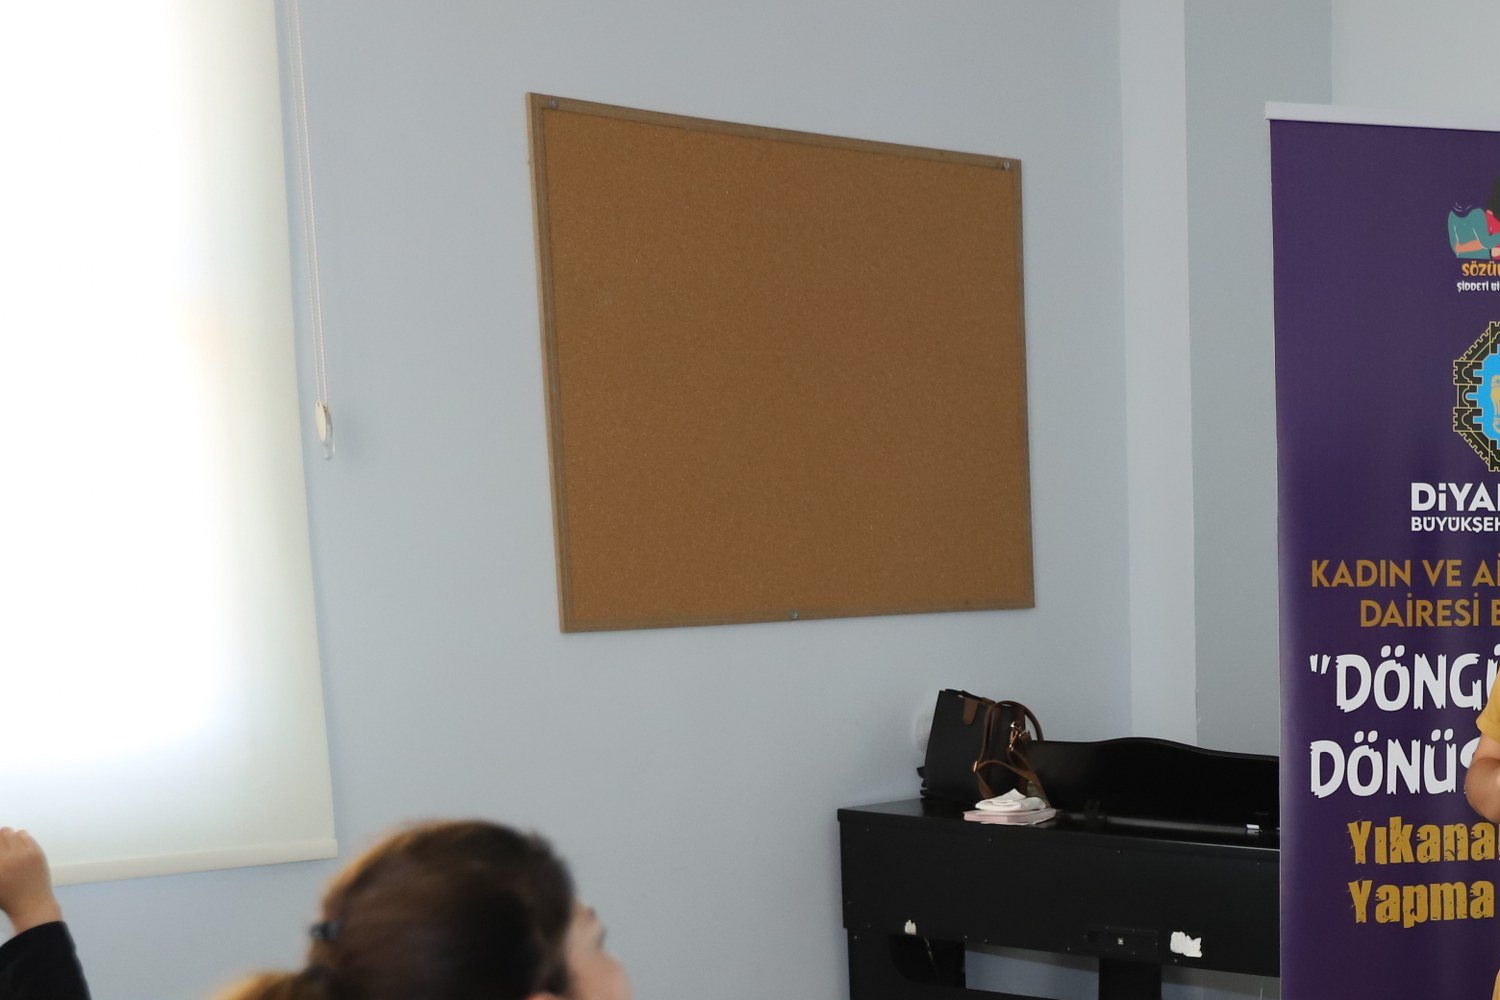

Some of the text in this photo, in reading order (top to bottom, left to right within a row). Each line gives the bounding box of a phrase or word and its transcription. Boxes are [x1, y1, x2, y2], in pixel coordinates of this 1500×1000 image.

[1456, 280, 1489, 293] ŞİDDETİ
[1311, 559, 1412, 588] KADIN
[1422, 559, 1463, 588] VE
[1360, 592, 1480, 628] DAİRESİ
[1348, 879, 1496, 929] Yapma
